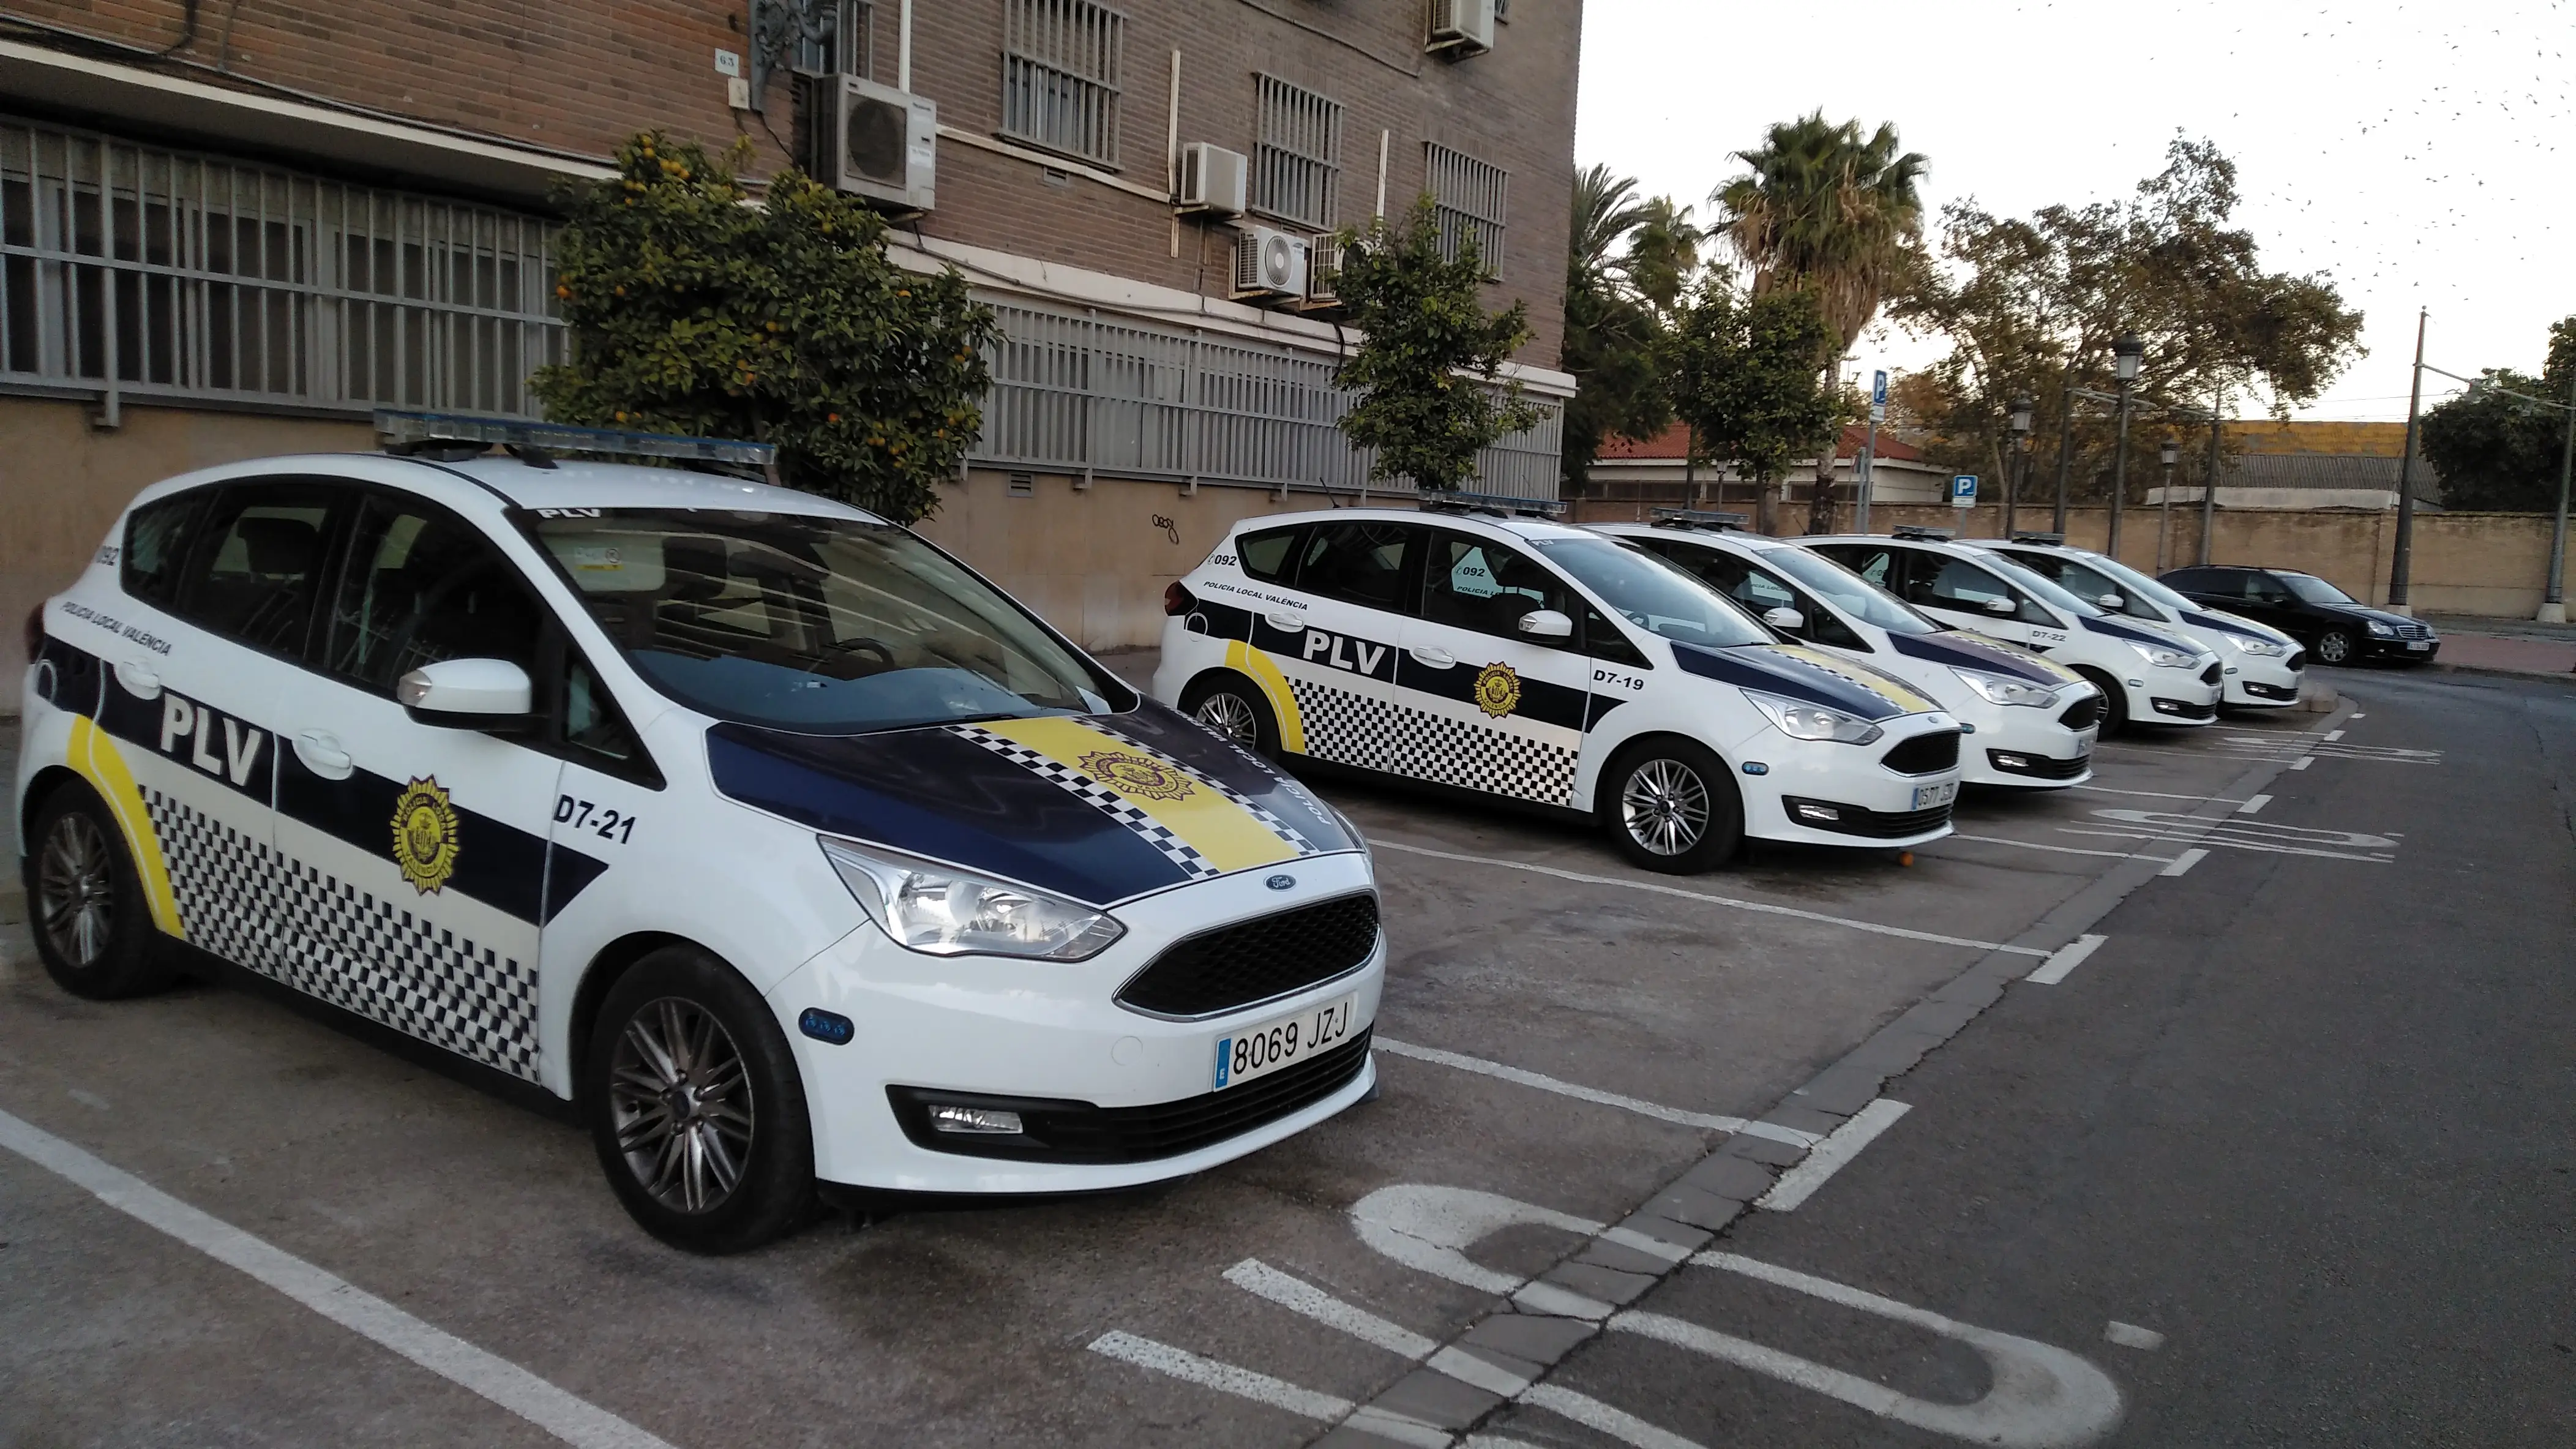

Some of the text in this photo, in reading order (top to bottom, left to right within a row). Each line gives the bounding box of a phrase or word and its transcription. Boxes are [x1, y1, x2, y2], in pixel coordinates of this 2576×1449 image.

[1875, 374, 1885, 399] P
[1958, 479, 1971, 494] P
[536, 509, 601, 518] PLV
[1215, 555, 1237, 566] 092
[1462, 567, 1485, 577] 092
[1204, 581, 1235, 592] POLICIA
[1236, 588, 1263, 599] LOCAL
[1457, 586, 1488, 596] POLICIA
[91, 613, 122, 634] LOCAL
[2032, 631, 2067, 642] D7-22
[1303, 629, 1386, 675] PLV
[1593, 669, 1644, 691] D7-19
[160, 692, 261, 787] PLV
[1228, 744, 1276, 774] LOCAL
[1273, 776, 1331, 825] POLICIA
[553, 794, 636, 844] D7-21
[1271, 876, 1291, 888] Ford
[1233, 1002, 1347, 1075] 8069 JZJ
[1219, 1067, 1226, 1080] E
